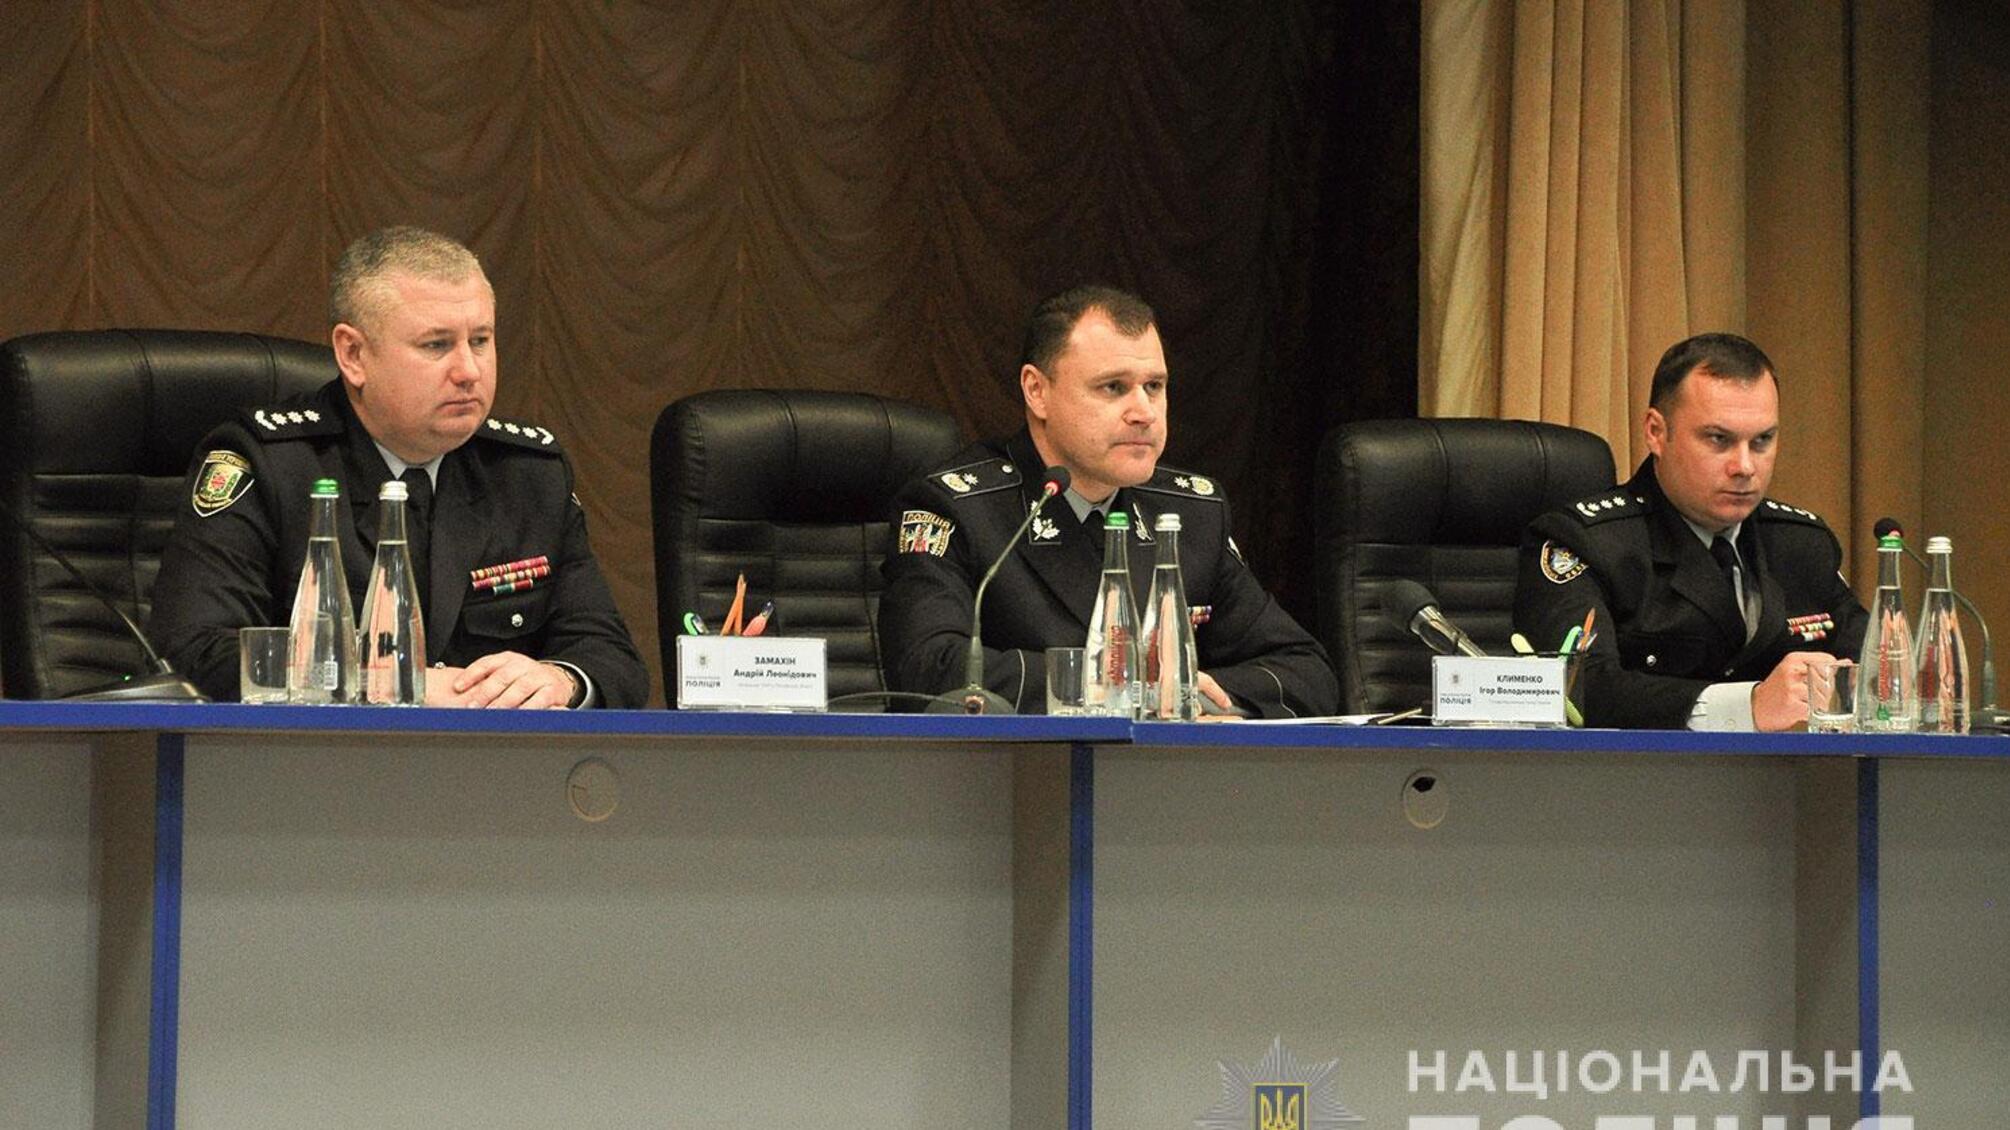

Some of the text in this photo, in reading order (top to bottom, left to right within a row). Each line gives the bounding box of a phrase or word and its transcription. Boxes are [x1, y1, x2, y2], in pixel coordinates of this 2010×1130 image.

[754, 656, 796, 666] ЗАМАХІН
[733, 669, 764, 679] Андрій
[766, 669, 817, 681] Леонідович
[1496, 674, 1543, 684] КЛИМЕНКО
[685, 680, 721, 688] ПОЛІЦІЯ
[1479, 687, 1496, 696] Ігор
[1497, 687, 1560, 697] Володимирович
[1440, 697, 1472, 705] ПОЛІЦІЯ
